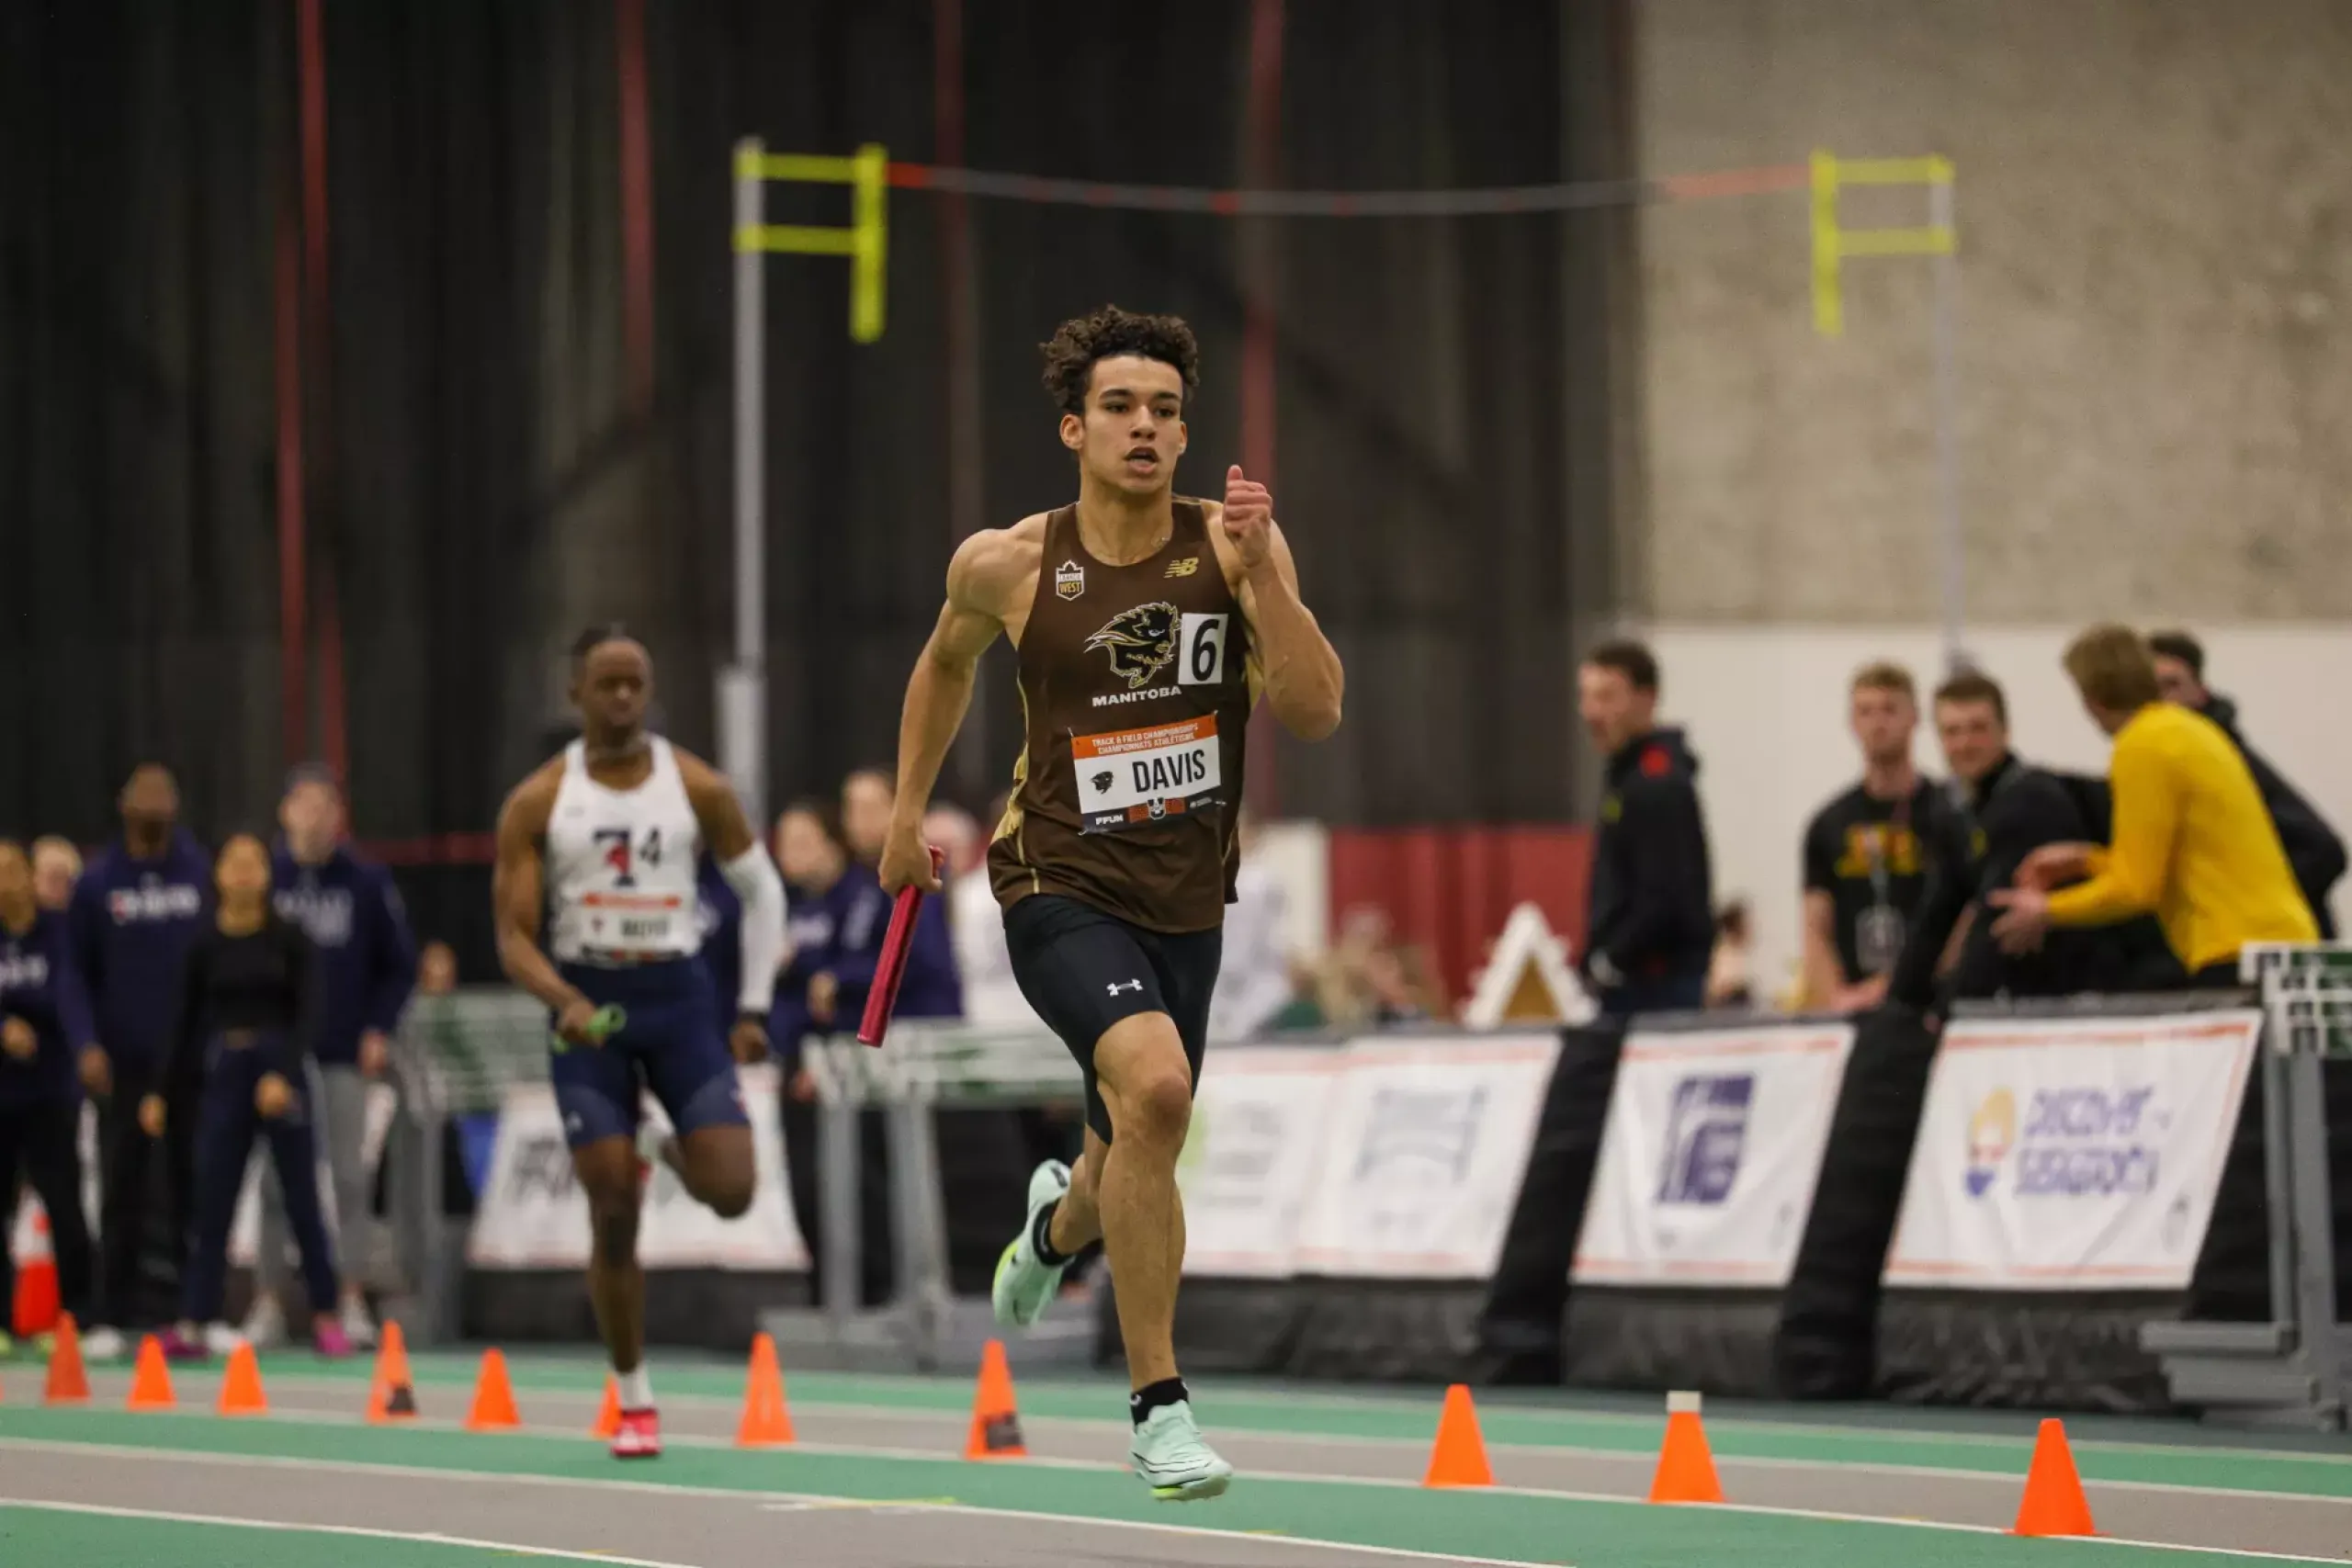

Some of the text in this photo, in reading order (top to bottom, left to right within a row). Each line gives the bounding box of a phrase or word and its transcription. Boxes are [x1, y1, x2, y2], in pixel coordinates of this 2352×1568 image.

[1059, 582, 1081, 593] WEST
[1192, 618, 1220, 682] 6
[1091, 685, 1182, 707] MANITOBA
[1091, 737, 1114, 747] TRACK
[1123, 732, 1143, 743] FIELD
[1132, 749, 1205, 793] DAVIS
